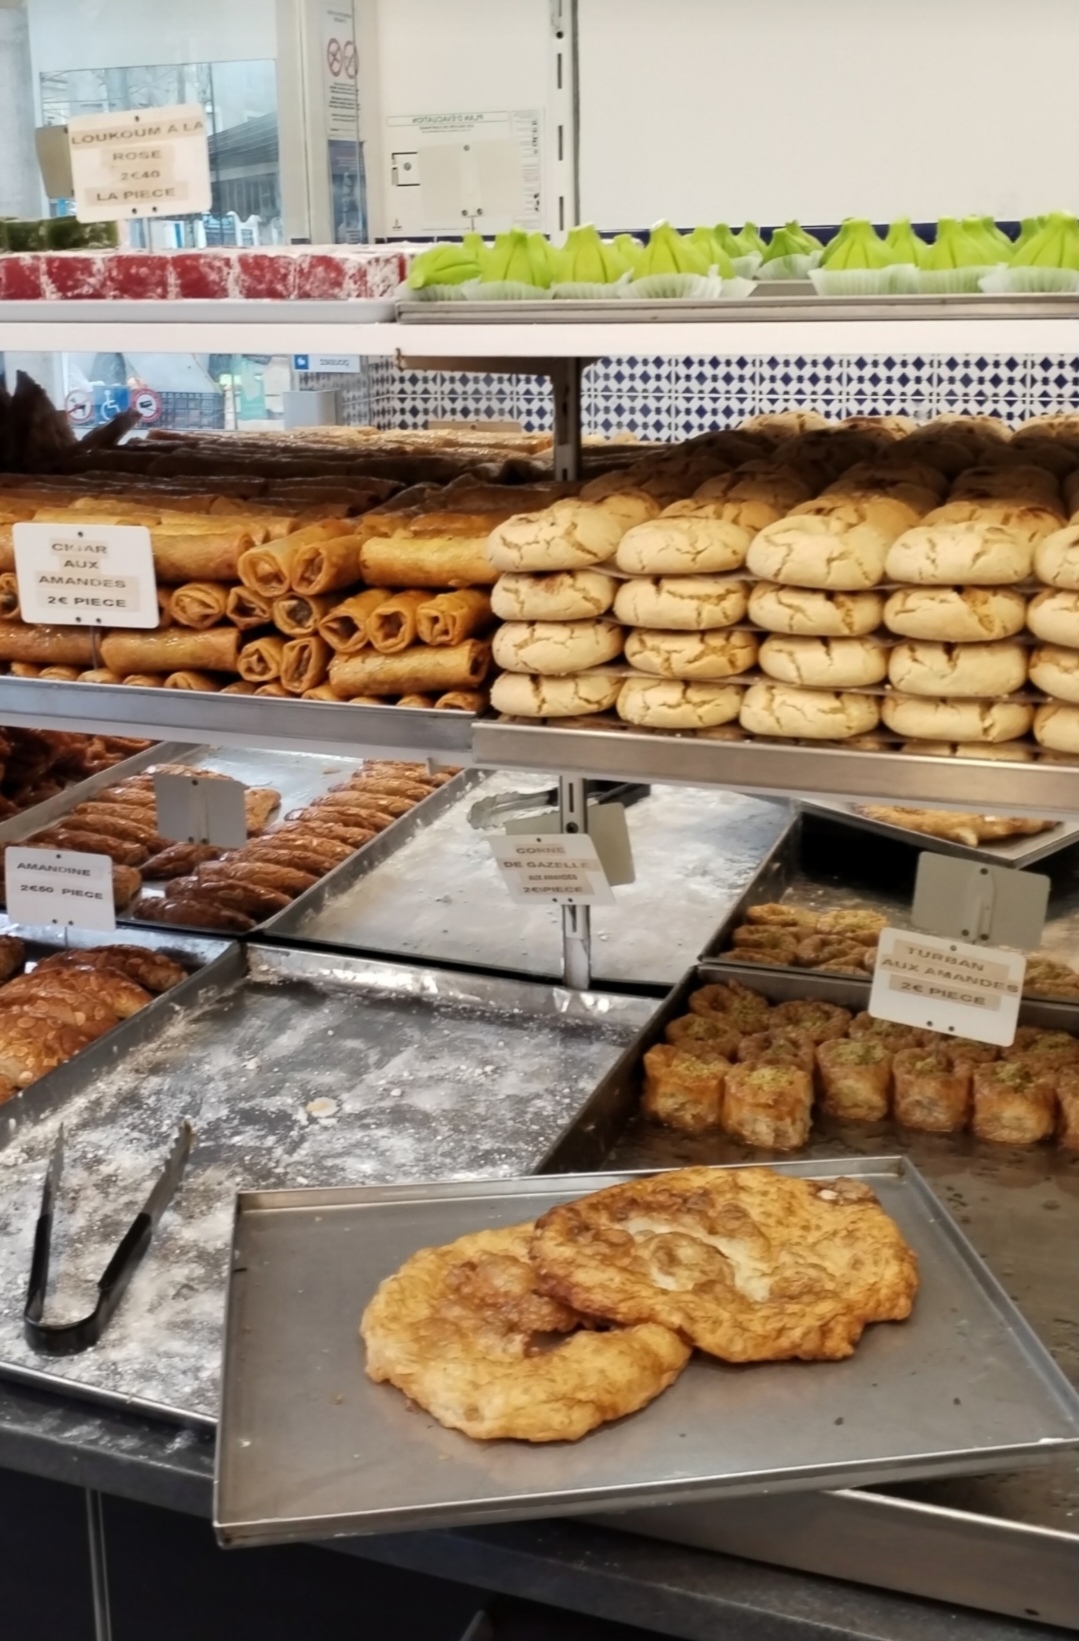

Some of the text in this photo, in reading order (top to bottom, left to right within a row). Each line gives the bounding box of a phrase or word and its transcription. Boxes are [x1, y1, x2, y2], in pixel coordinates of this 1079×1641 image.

[71, 127, 161, 145] LOUKOUM
[183, 121, 203, 132] LA
[112, 150, 163, 161] ROSE
[120, 170, 161, 181] 2€40
[96, 188, 176, 202] LA PIECE
[63, 560, 99, 569] AUX
[38, 576, 126, 588] AMANDES
[47, 596, 127, 608] 2€ PIECE
[516, 847, 566, 855] CORNE
[17, 863, 91, 877] AMANDINE
[526, 861, 590, 869] GAZELLE
[61, 888, 104, 900] PIECE
[907, 947, 984, 971] TURBAN
[881, 958, 1019, 993] AUX AMANDES
[901, 981, 986, 1006] 2€ PIECE
